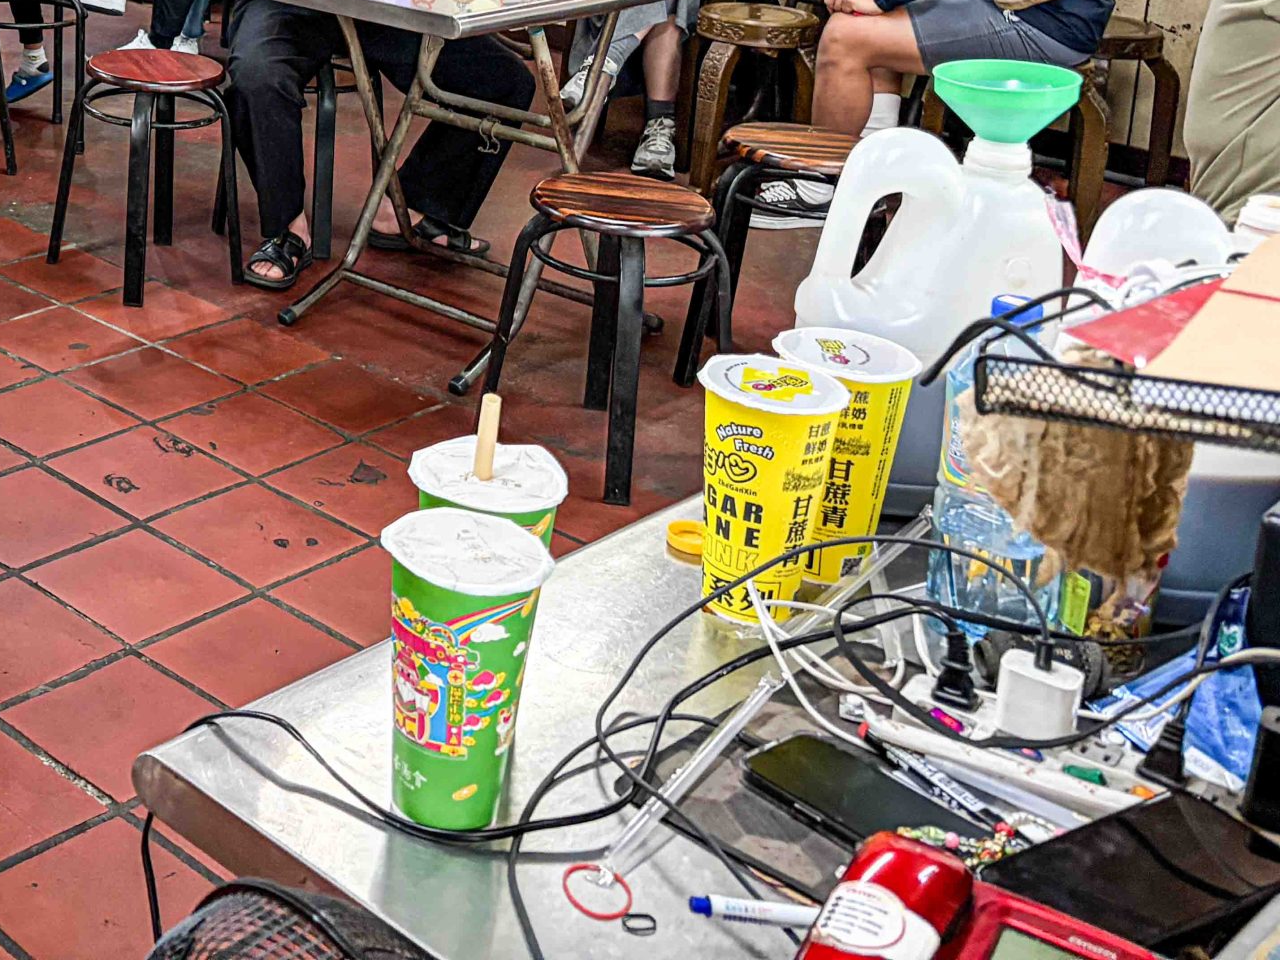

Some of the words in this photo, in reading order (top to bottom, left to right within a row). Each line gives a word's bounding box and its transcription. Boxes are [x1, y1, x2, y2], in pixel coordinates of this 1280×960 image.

[716, 422, 763, 441] Nature
[734, 438, 774, 460] Fresh
[821, 458, 855, 529] 甘蔗青
